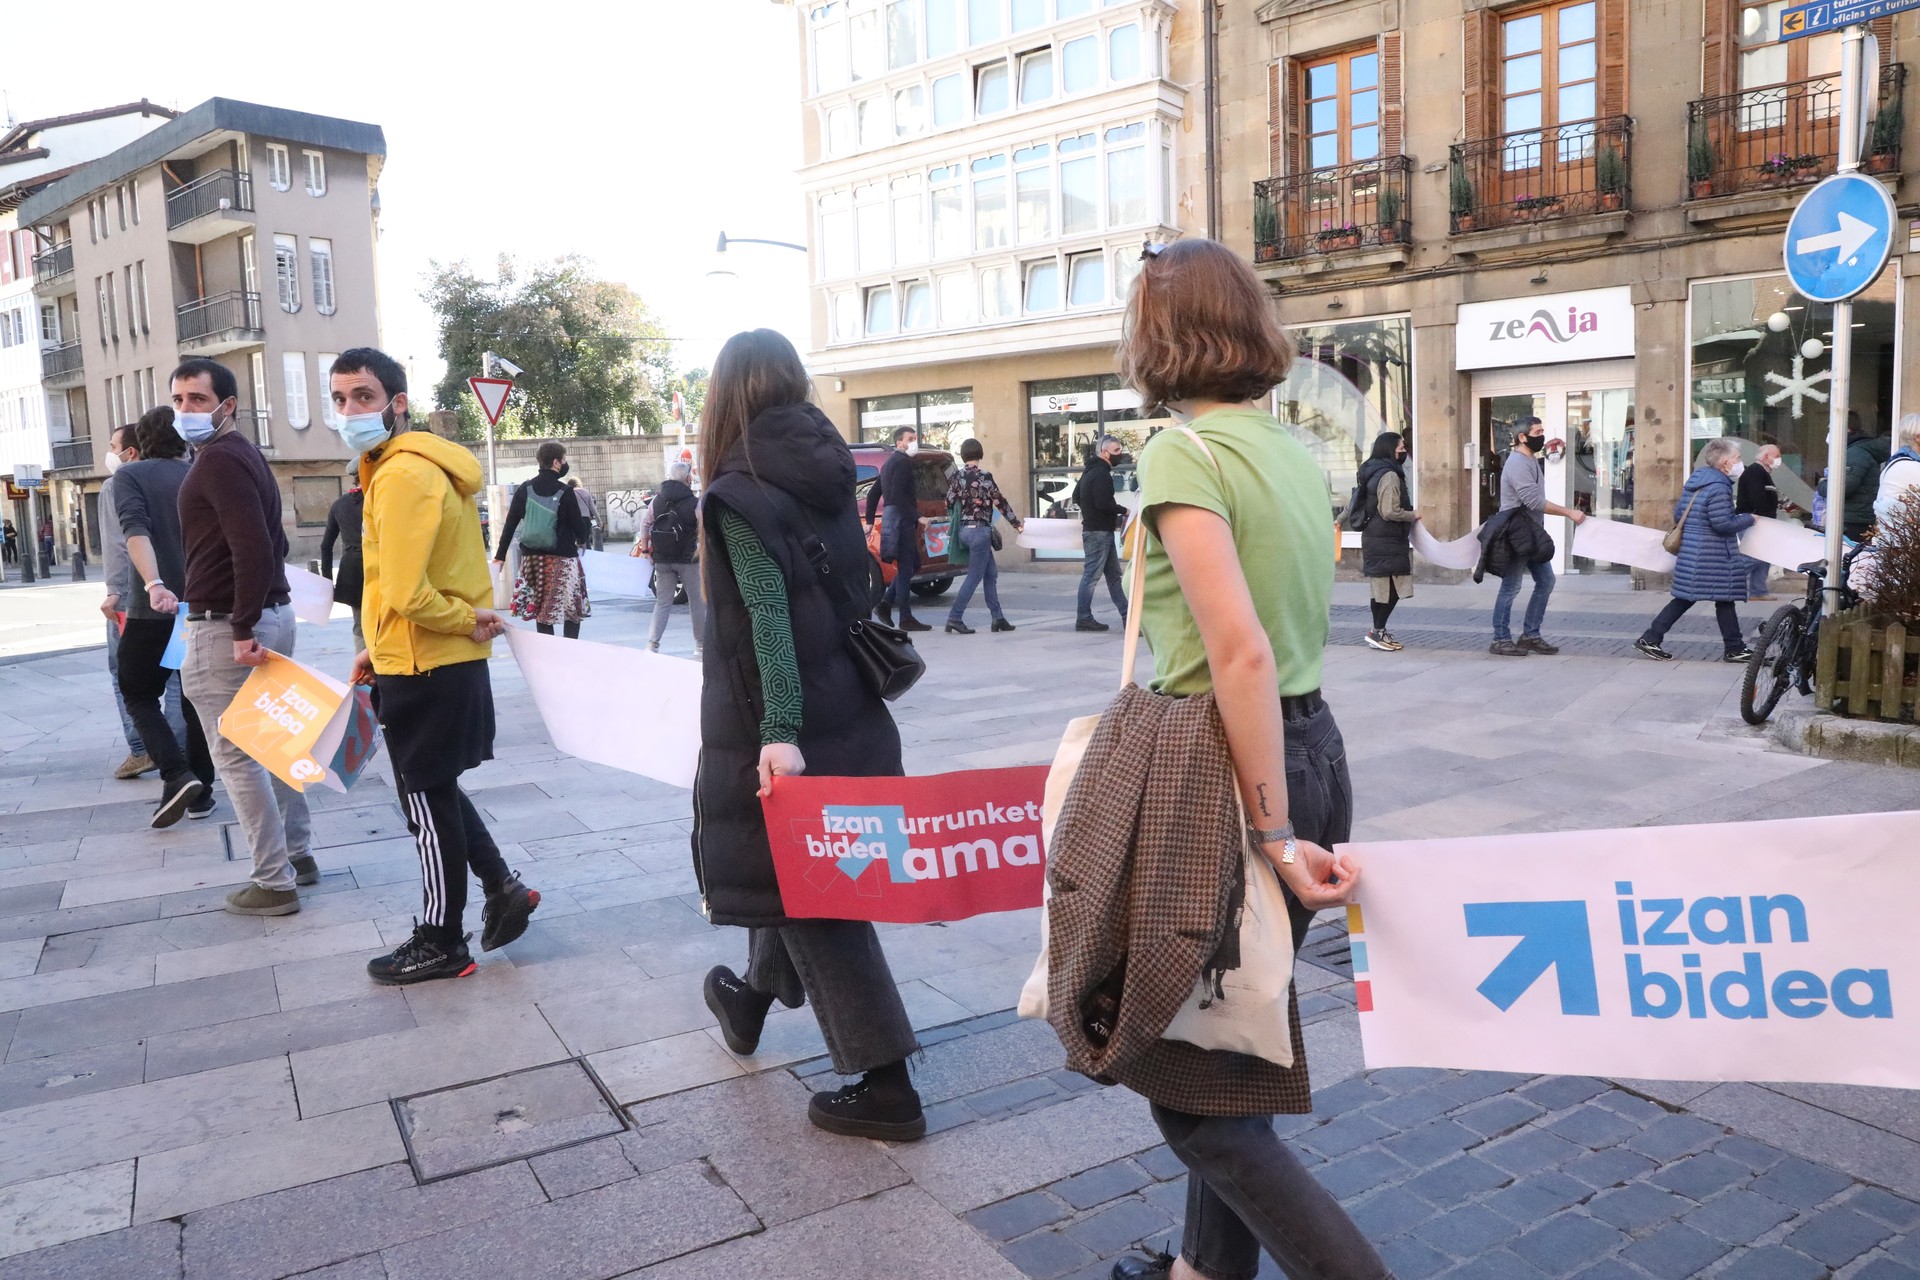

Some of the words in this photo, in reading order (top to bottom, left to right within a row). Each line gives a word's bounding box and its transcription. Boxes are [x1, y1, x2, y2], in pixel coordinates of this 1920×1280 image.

[1832, 9, 1866, 25] oficina
[1869, 6, 1881, 15] de
[254, 692, 304, 735] bidea
[281, 684, 319, 720] izan
[821, 809, 884, 834] izan
[897, 800, 1045, 835] urrunket
[805, 834, 888, 859] bidea
[1615, 881, 1809, 945] izan
[401, 964, 417, 974] new
[418, 954, 447, 968] balance
[1624, 952, 1894, 1019] bidea
